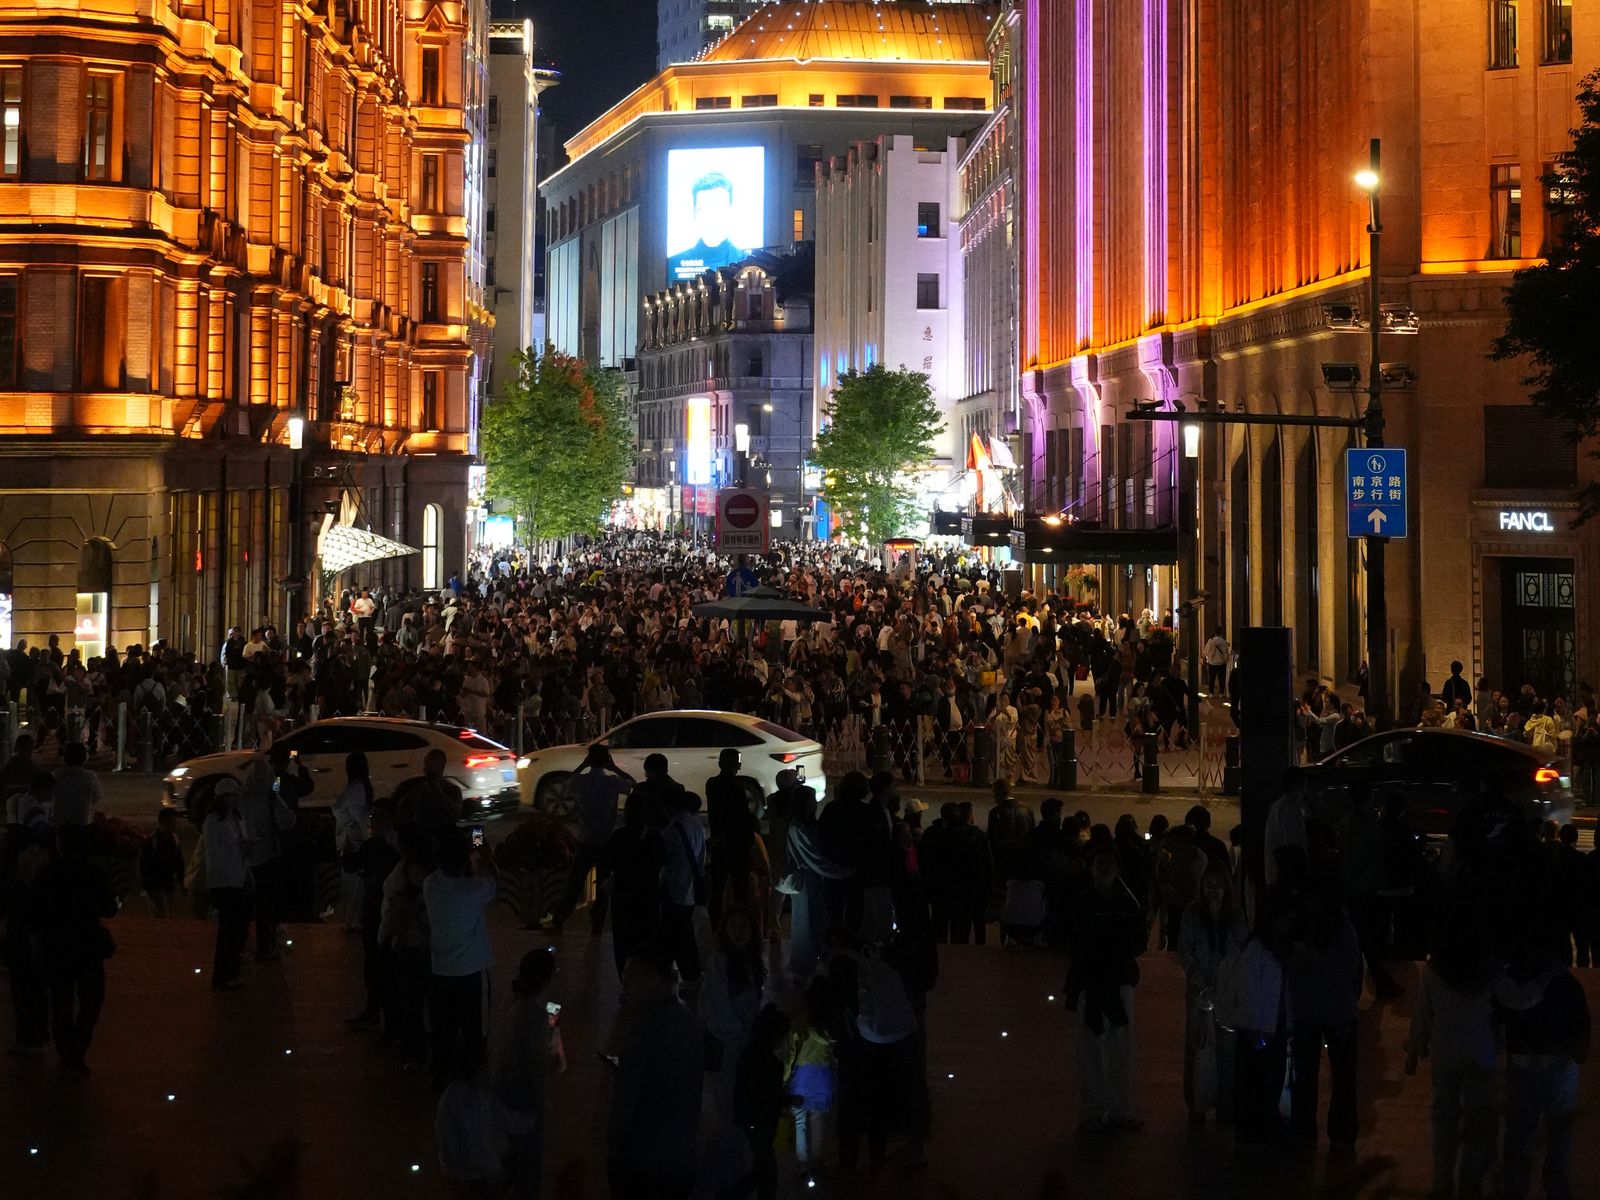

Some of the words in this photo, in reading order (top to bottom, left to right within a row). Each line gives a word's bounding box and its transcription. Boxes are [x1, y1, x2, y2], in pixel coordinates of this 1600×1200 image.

[1352, 475, 1401, 487] 南京路
[1352, 488, 1401, 500] 步行街
[1500, 512, 1553, 531] FANCL
